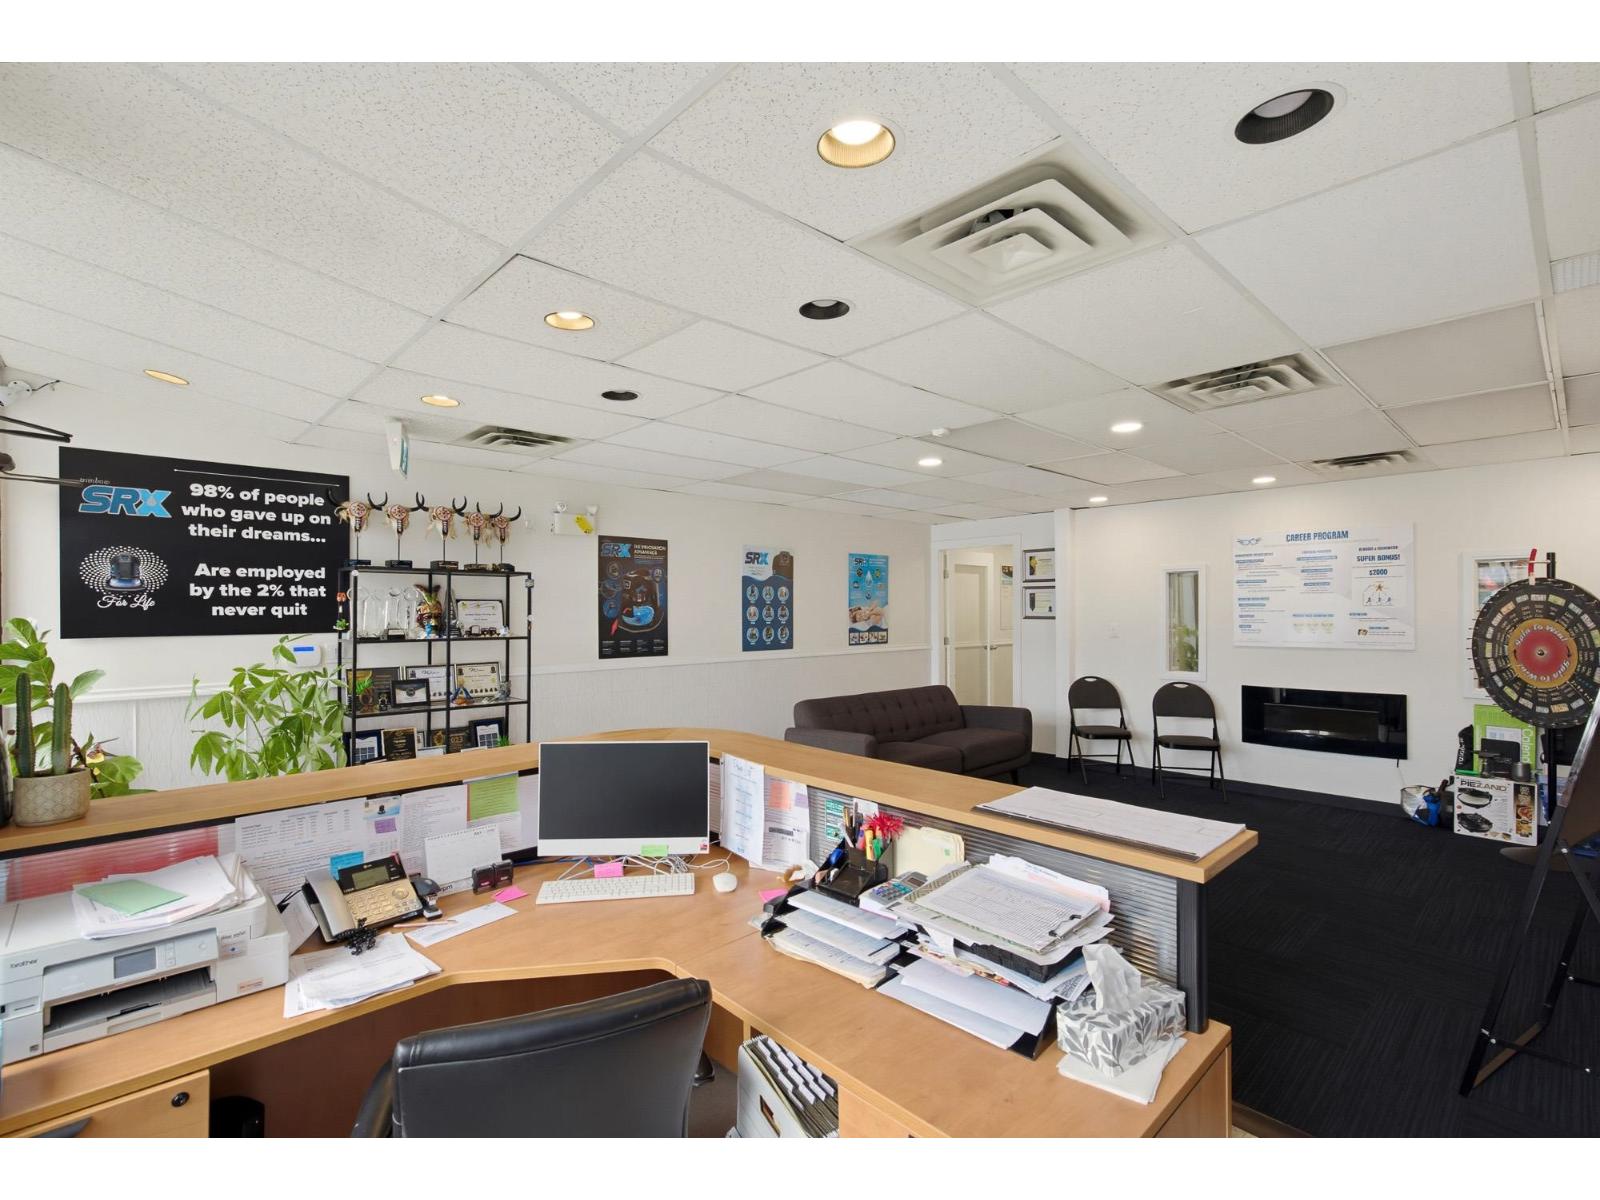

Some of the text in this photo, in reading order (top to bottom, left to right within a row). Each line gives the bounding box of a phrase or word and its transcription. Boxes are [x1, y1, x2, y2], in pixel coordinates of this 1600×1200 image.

[78, 484, 172, 518] SRX
[189, 483, 325, 507] 98% of people
[181, 504, 331, 525] who gave up on
[188, 523, 326, 543] their dreams...
[1286, 530, 1349, 542] CAREER PROGRAM
[744, 551, 769, 565] SRX
[194, 563, 326, 581] Are employed
[189, 583, 327, 599] by the 2% that
[97, 594, 156, 611] For Life
[211, 603, 308, 619] never quit
